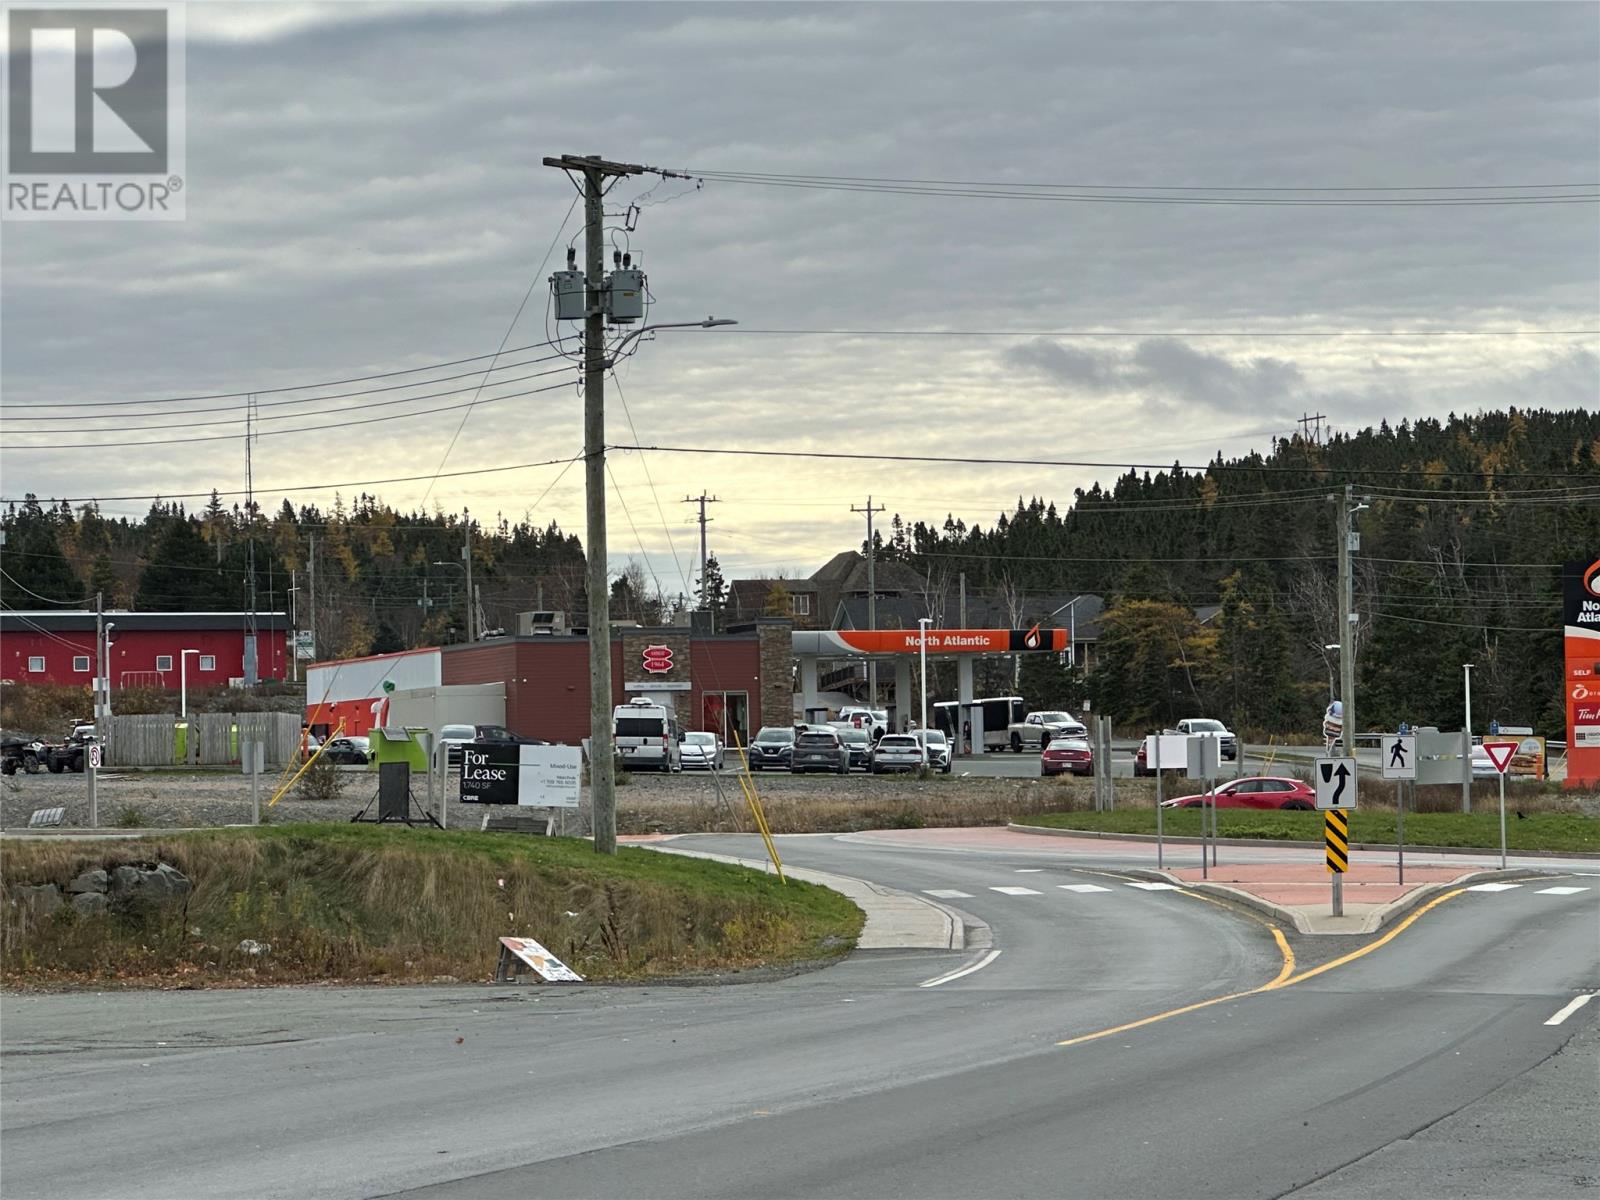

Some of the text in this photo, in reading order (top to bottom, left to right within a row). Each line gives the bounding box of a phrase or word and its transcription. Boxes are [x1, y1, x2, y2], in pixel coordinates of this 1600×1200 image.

[943, 636, 990, 646] Atlantic
[1578, 708, 1595, 720] Tim
[464, 750, 489, 765] For
[463, 764, 507, 780] Lease
[481, 781, 491, 789] SF
